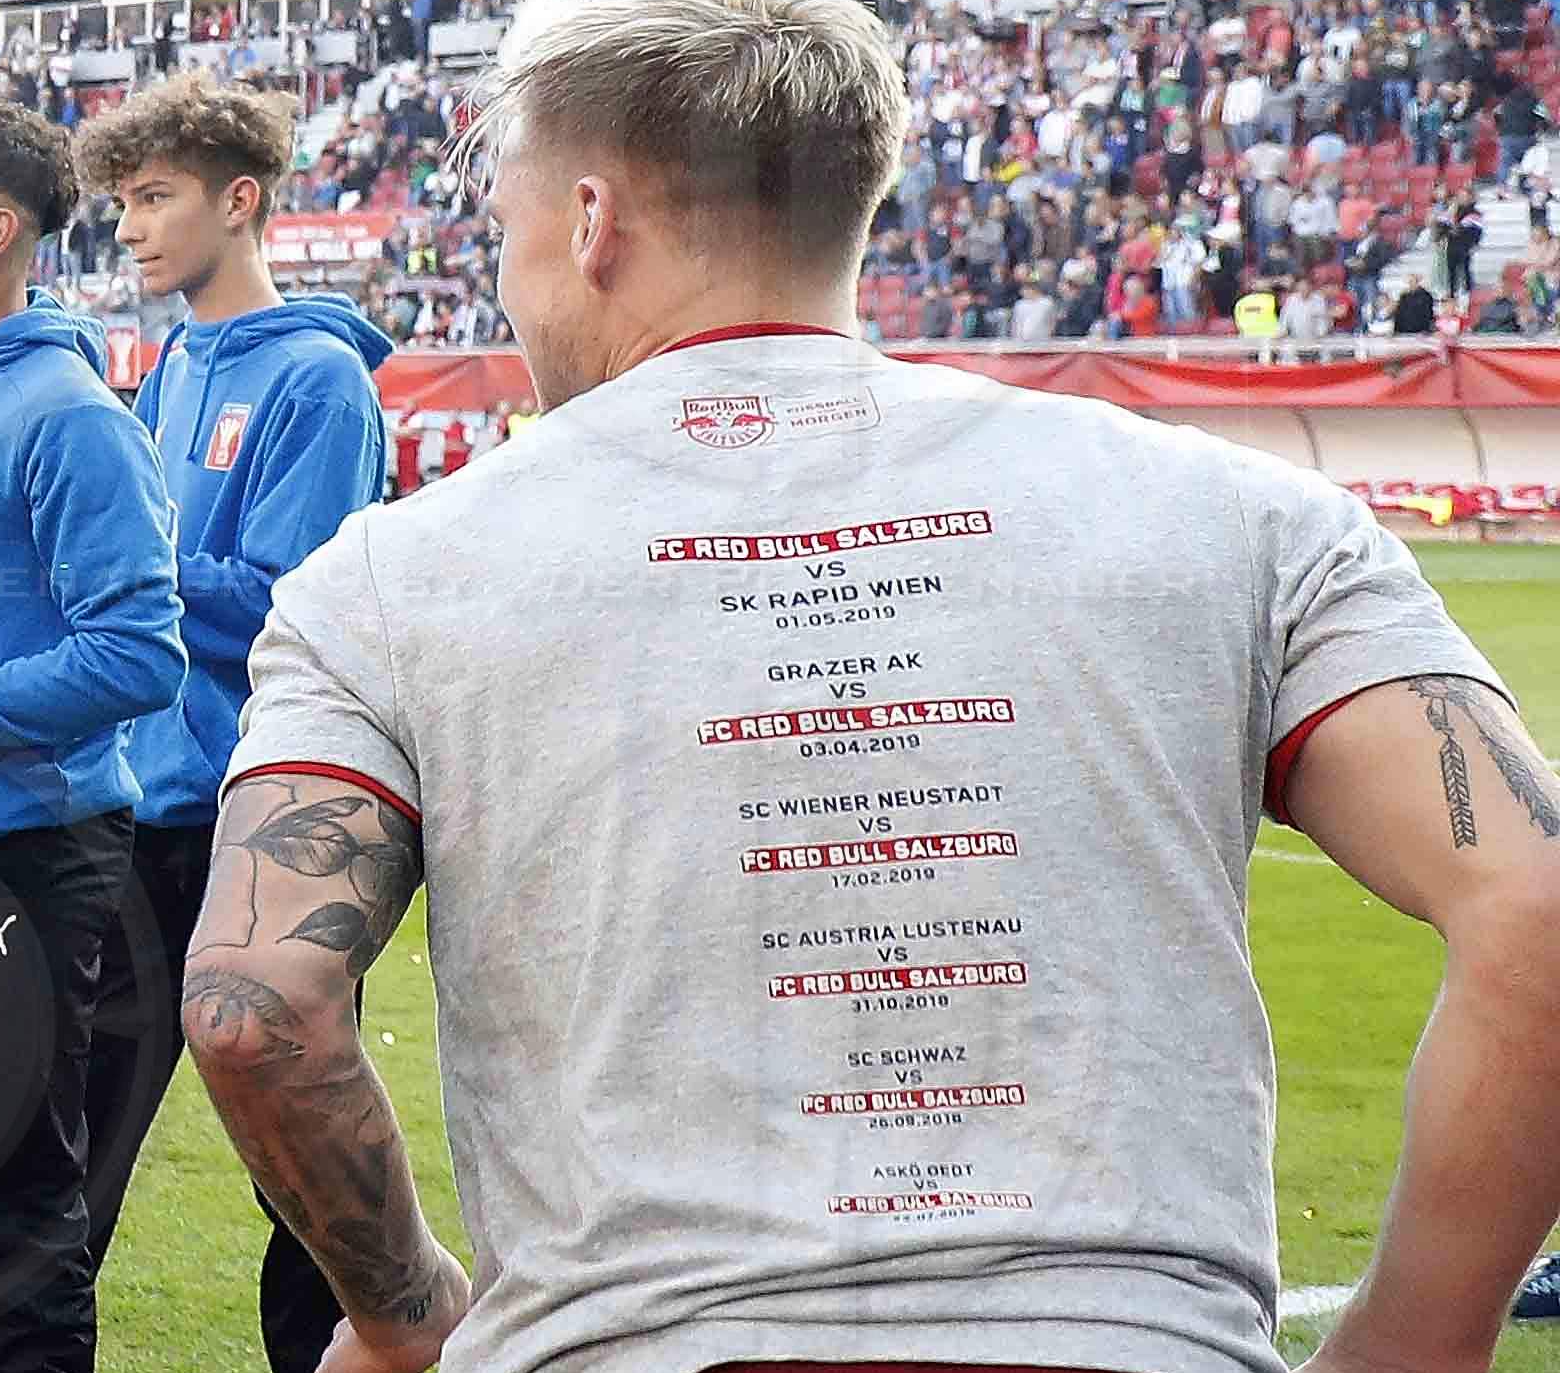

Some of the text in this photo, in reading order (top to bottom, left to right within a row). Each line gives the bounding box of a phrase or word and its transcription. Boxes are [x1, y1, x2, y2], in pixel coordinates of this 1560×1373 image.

[651, 513, 988, 560] FC RED BULL SALZBURG
[805, 561, 846, 578] VS
[720, 576, 942, 612] SK RAPID WIEN
[776, 606, 896, 628] 01.05.2019
[769, 653, 922, 681] GRAZER AK
[829, 682, 866, 698] VS
[701, 701, 1010, 741] FC RED BULL SALZBURG
[739, 786, 1002, 819] SC WIENER NEUSTADT
[859, 817, 891, 833] VS
[743, 834, 1014, 871] FC RED BULL SALZBURG
[763, 919, 1020, 950] SC AUSTRIA LUSTENAU
[878, 947, 908, 962] VS
[771, 965, 1022, 995] FC RED BULL SALZBURG
[848, 1047, 967, 1066] SC SCHWAZ
[895, 1070, 923, 1084] VS
